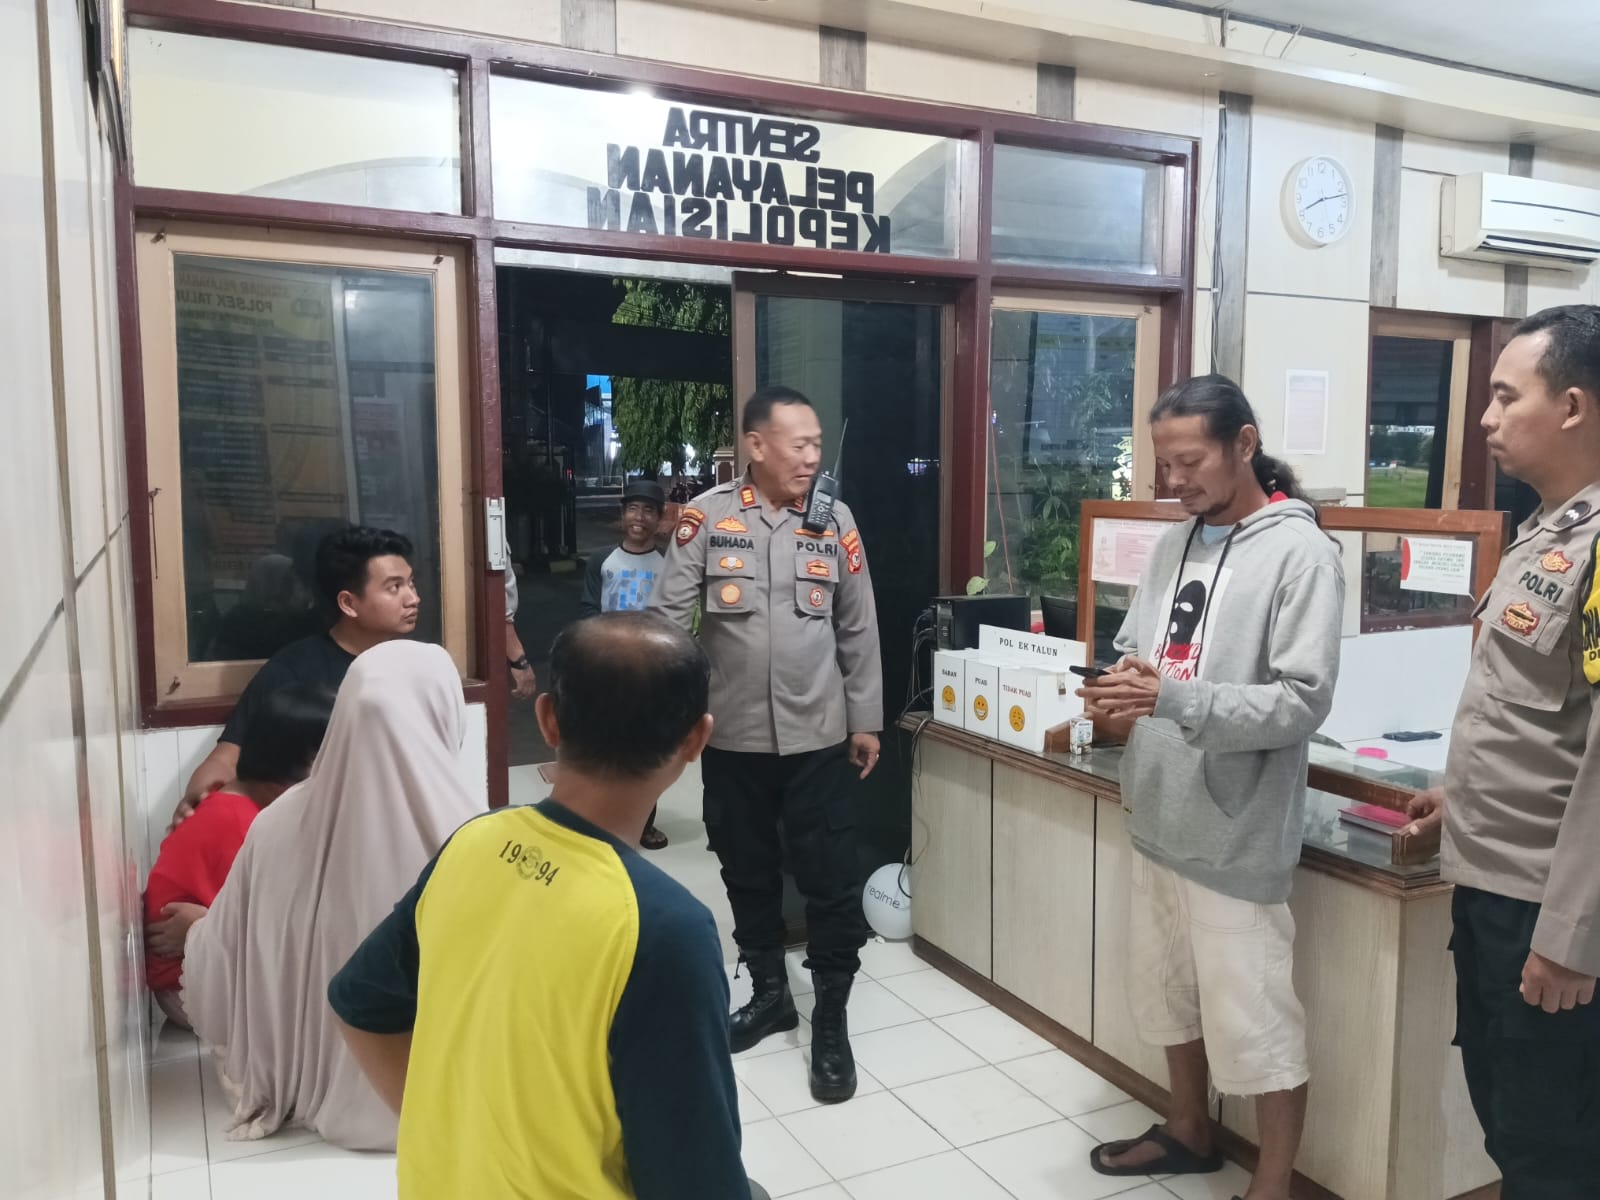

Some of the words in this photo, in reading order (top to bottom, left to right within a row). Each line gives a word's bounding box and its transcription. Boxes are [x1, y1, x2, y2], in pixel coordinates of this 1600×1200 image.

[796, 540, 838, 557] POLRI
[1518, 570, 1565, 604] POLRI
[1031, 644, 1058, 657] TALUN
